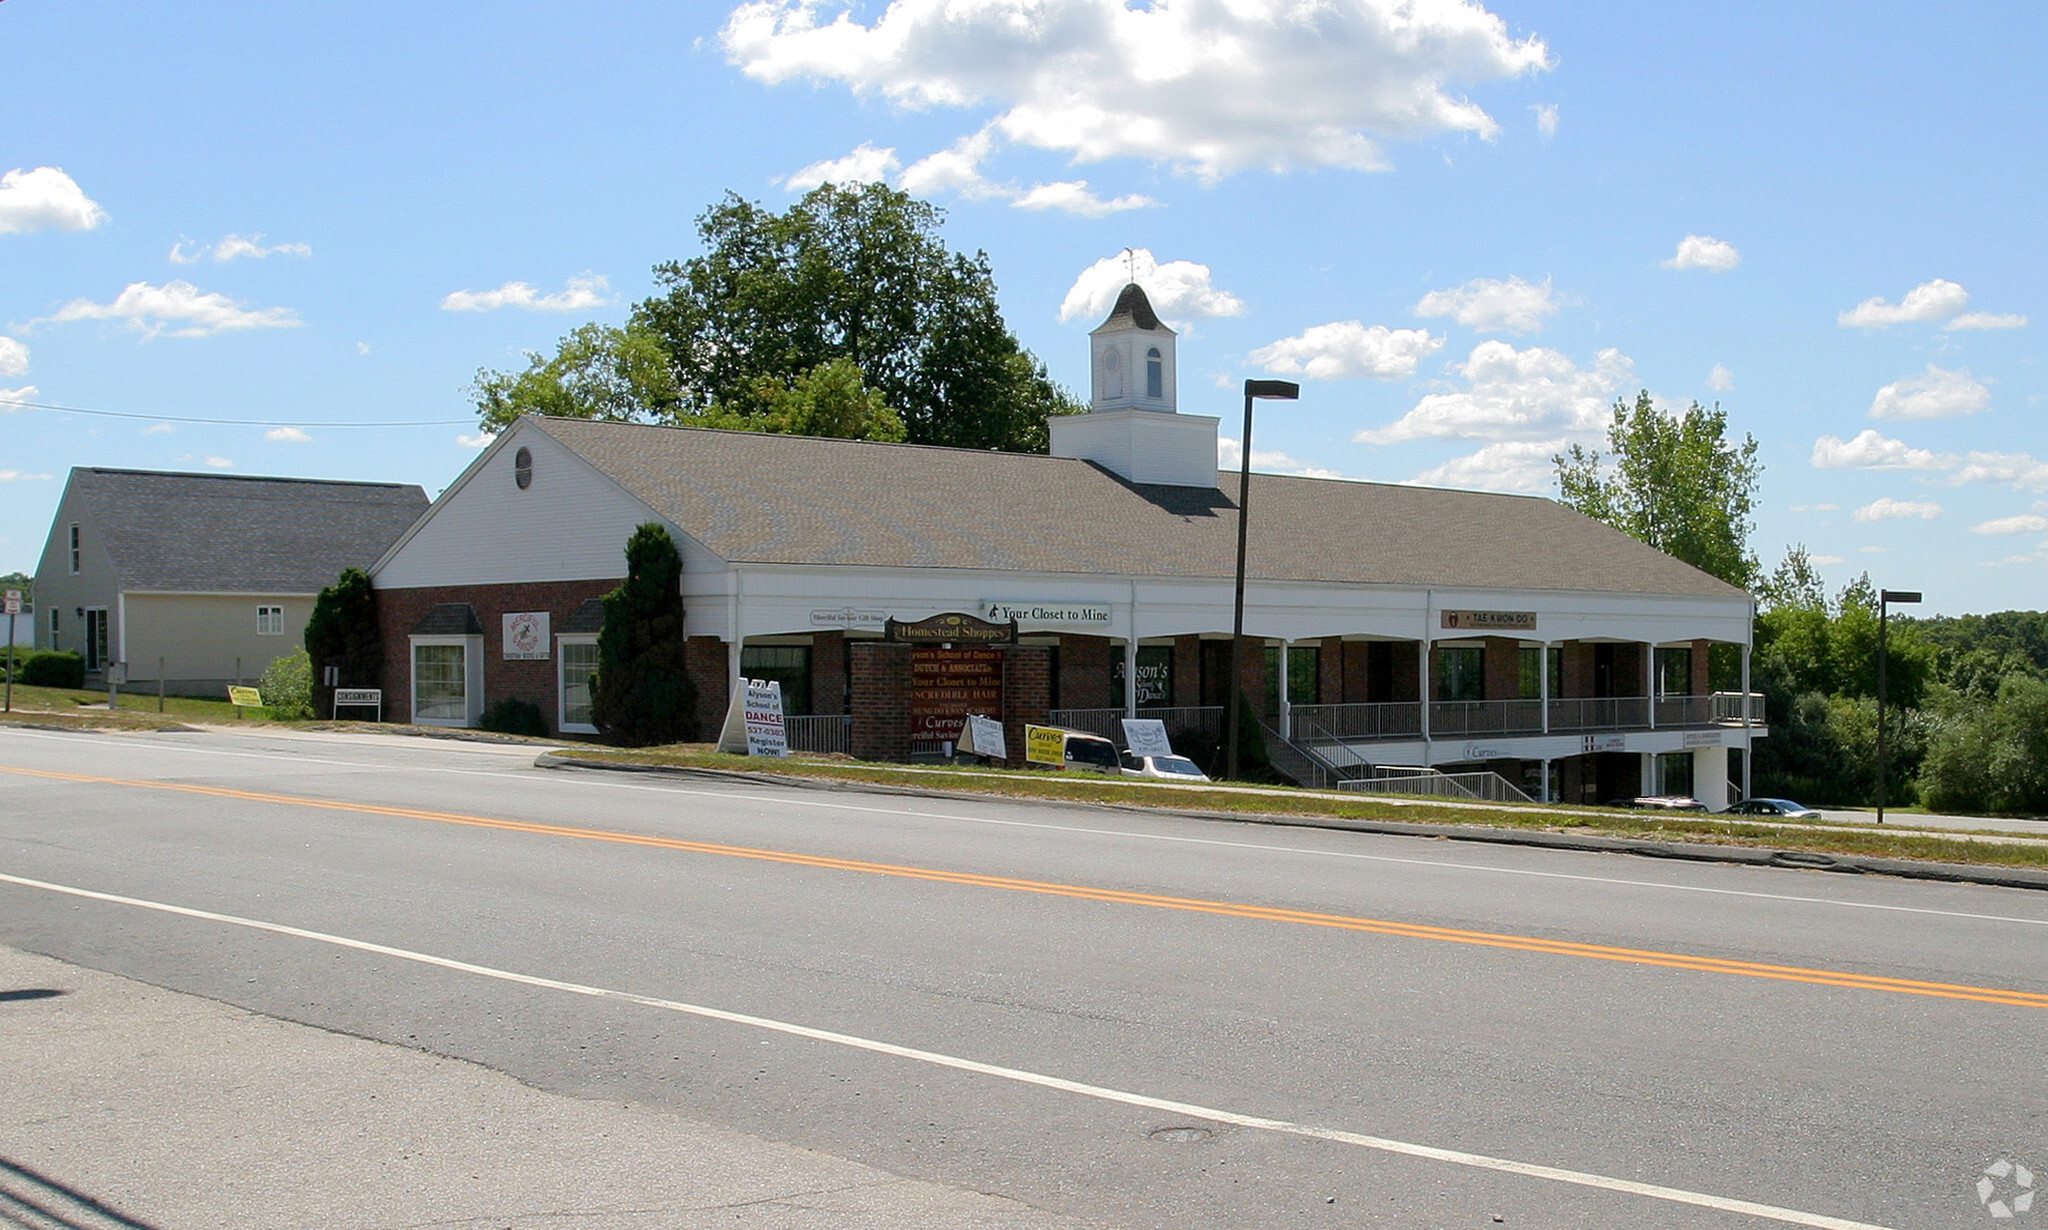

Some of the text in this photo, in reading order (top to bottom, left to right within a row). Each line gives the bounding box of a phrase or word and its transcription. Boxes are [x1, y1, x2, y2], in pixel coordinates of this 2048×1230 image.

[1003, 607, 1108, 621] Your Closet to Mine
[902, 625, 1005, 640] Homestead Shoppes
[912, 676, 936, 687] Your
[746, 700, 770, 709] School
[746, 711, 783, 723] DANCE
[925, 715, 964, 729] Curves
[1028, 726, 1063, 744] Curves
